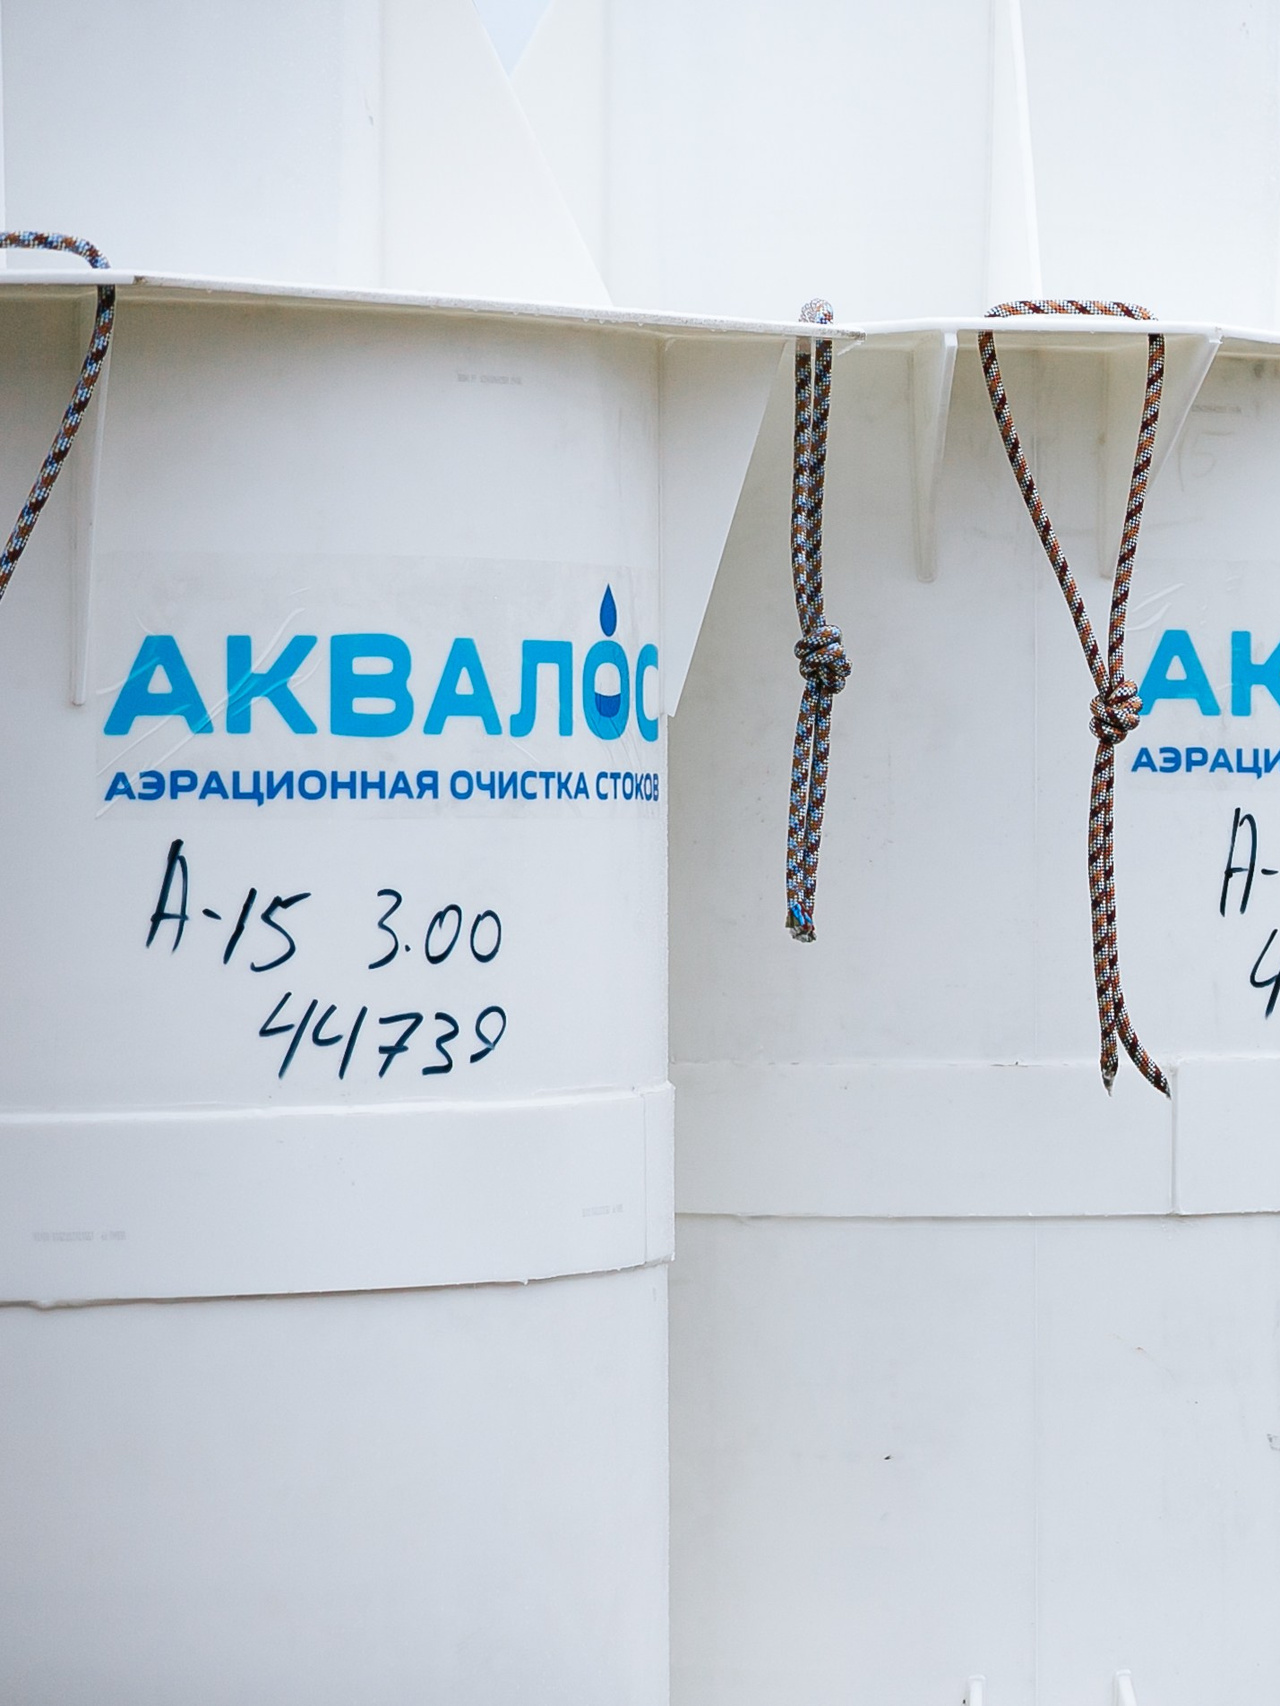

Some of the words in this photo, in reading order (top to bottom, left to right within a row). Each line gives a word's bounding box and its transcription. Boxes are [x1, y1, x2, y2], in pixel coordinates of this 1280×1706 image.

[103, 633, 659, 743] АКВАЛОС
[104, 770, 440, 807] АЭРАЦИОННАЯ
[449, 770, 590, 801] ОЧИСТКА
[595, 771, 659, 802] СТОКОВ
[367, 888, 502, 970] 3.00
